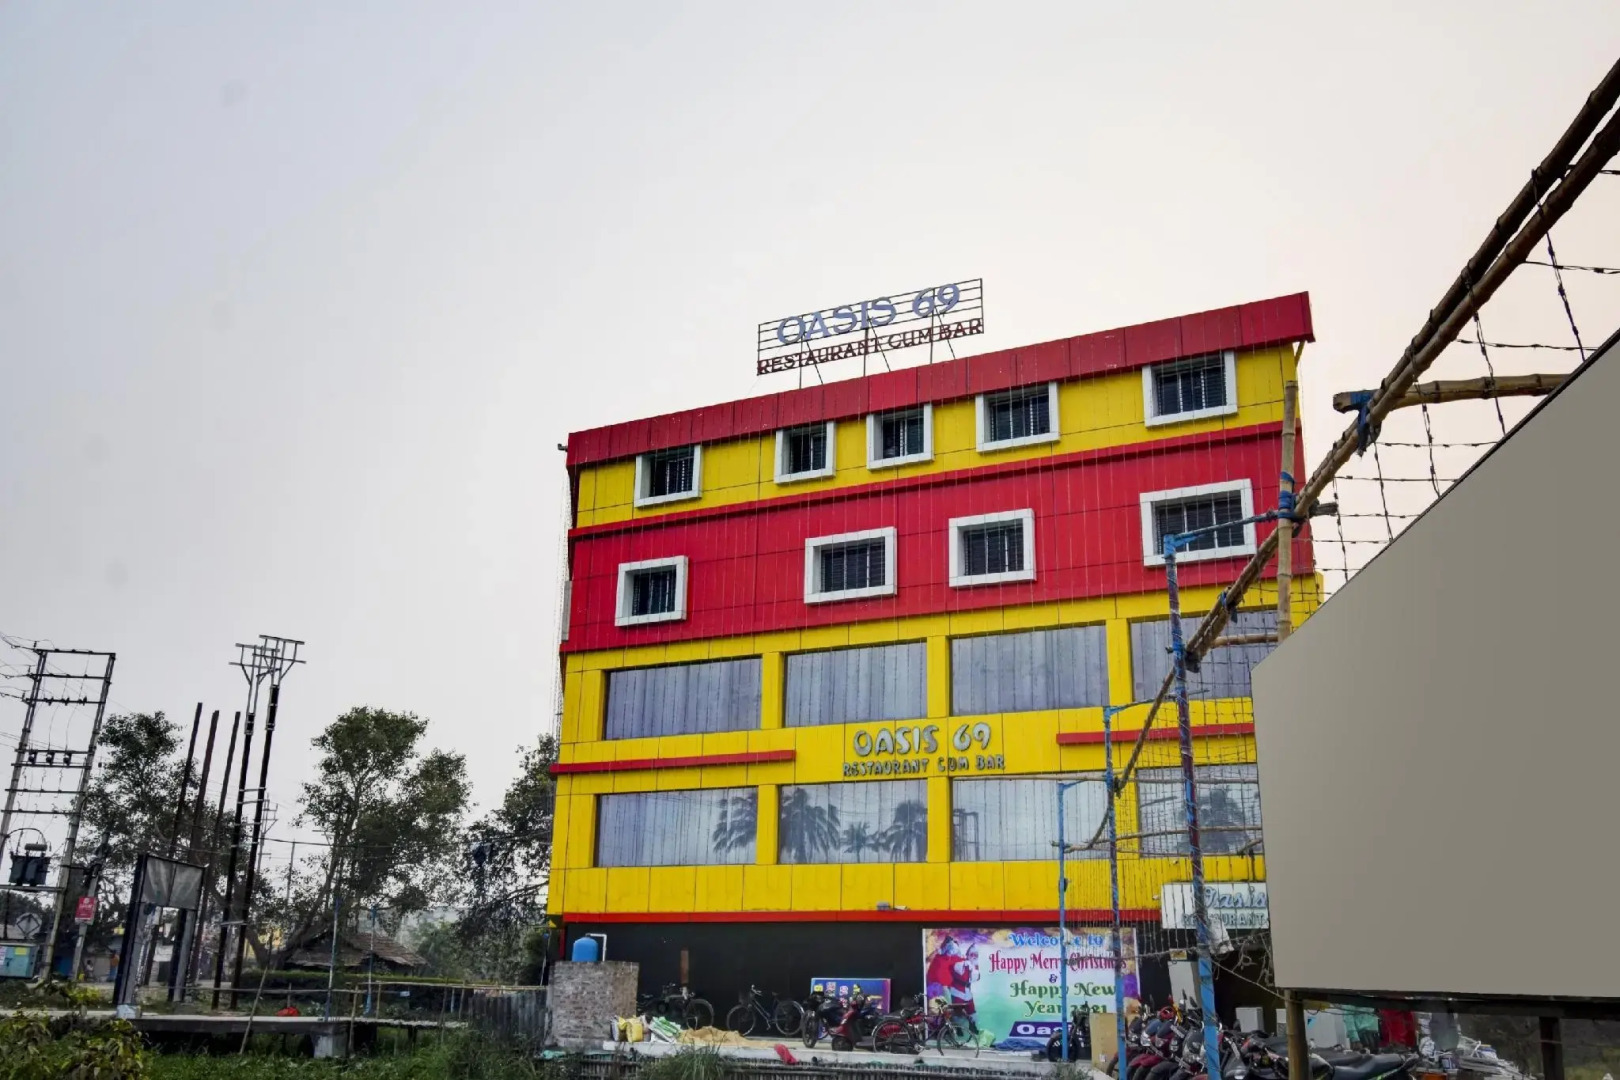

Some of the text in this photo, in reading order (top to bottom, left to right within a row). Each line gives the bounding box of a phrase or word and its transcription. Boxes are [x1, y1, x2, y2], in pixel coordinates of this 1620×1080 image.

[776, 284, 960, 345] OASIS 69
[757, 318, 984, 375] RESTAURANT CUM BAR
[853, 722, 991, 757] OASIS 69
[843, 754, 1006, 777] RESTAURANT CUM BAR
[1008, 932, 1104, 948] Welcoe to
[988, 950, 1127, 974] Happy Merr Christms
[1048, 974, 1058, 983] &
[1074, 981, 1116, 997] New
